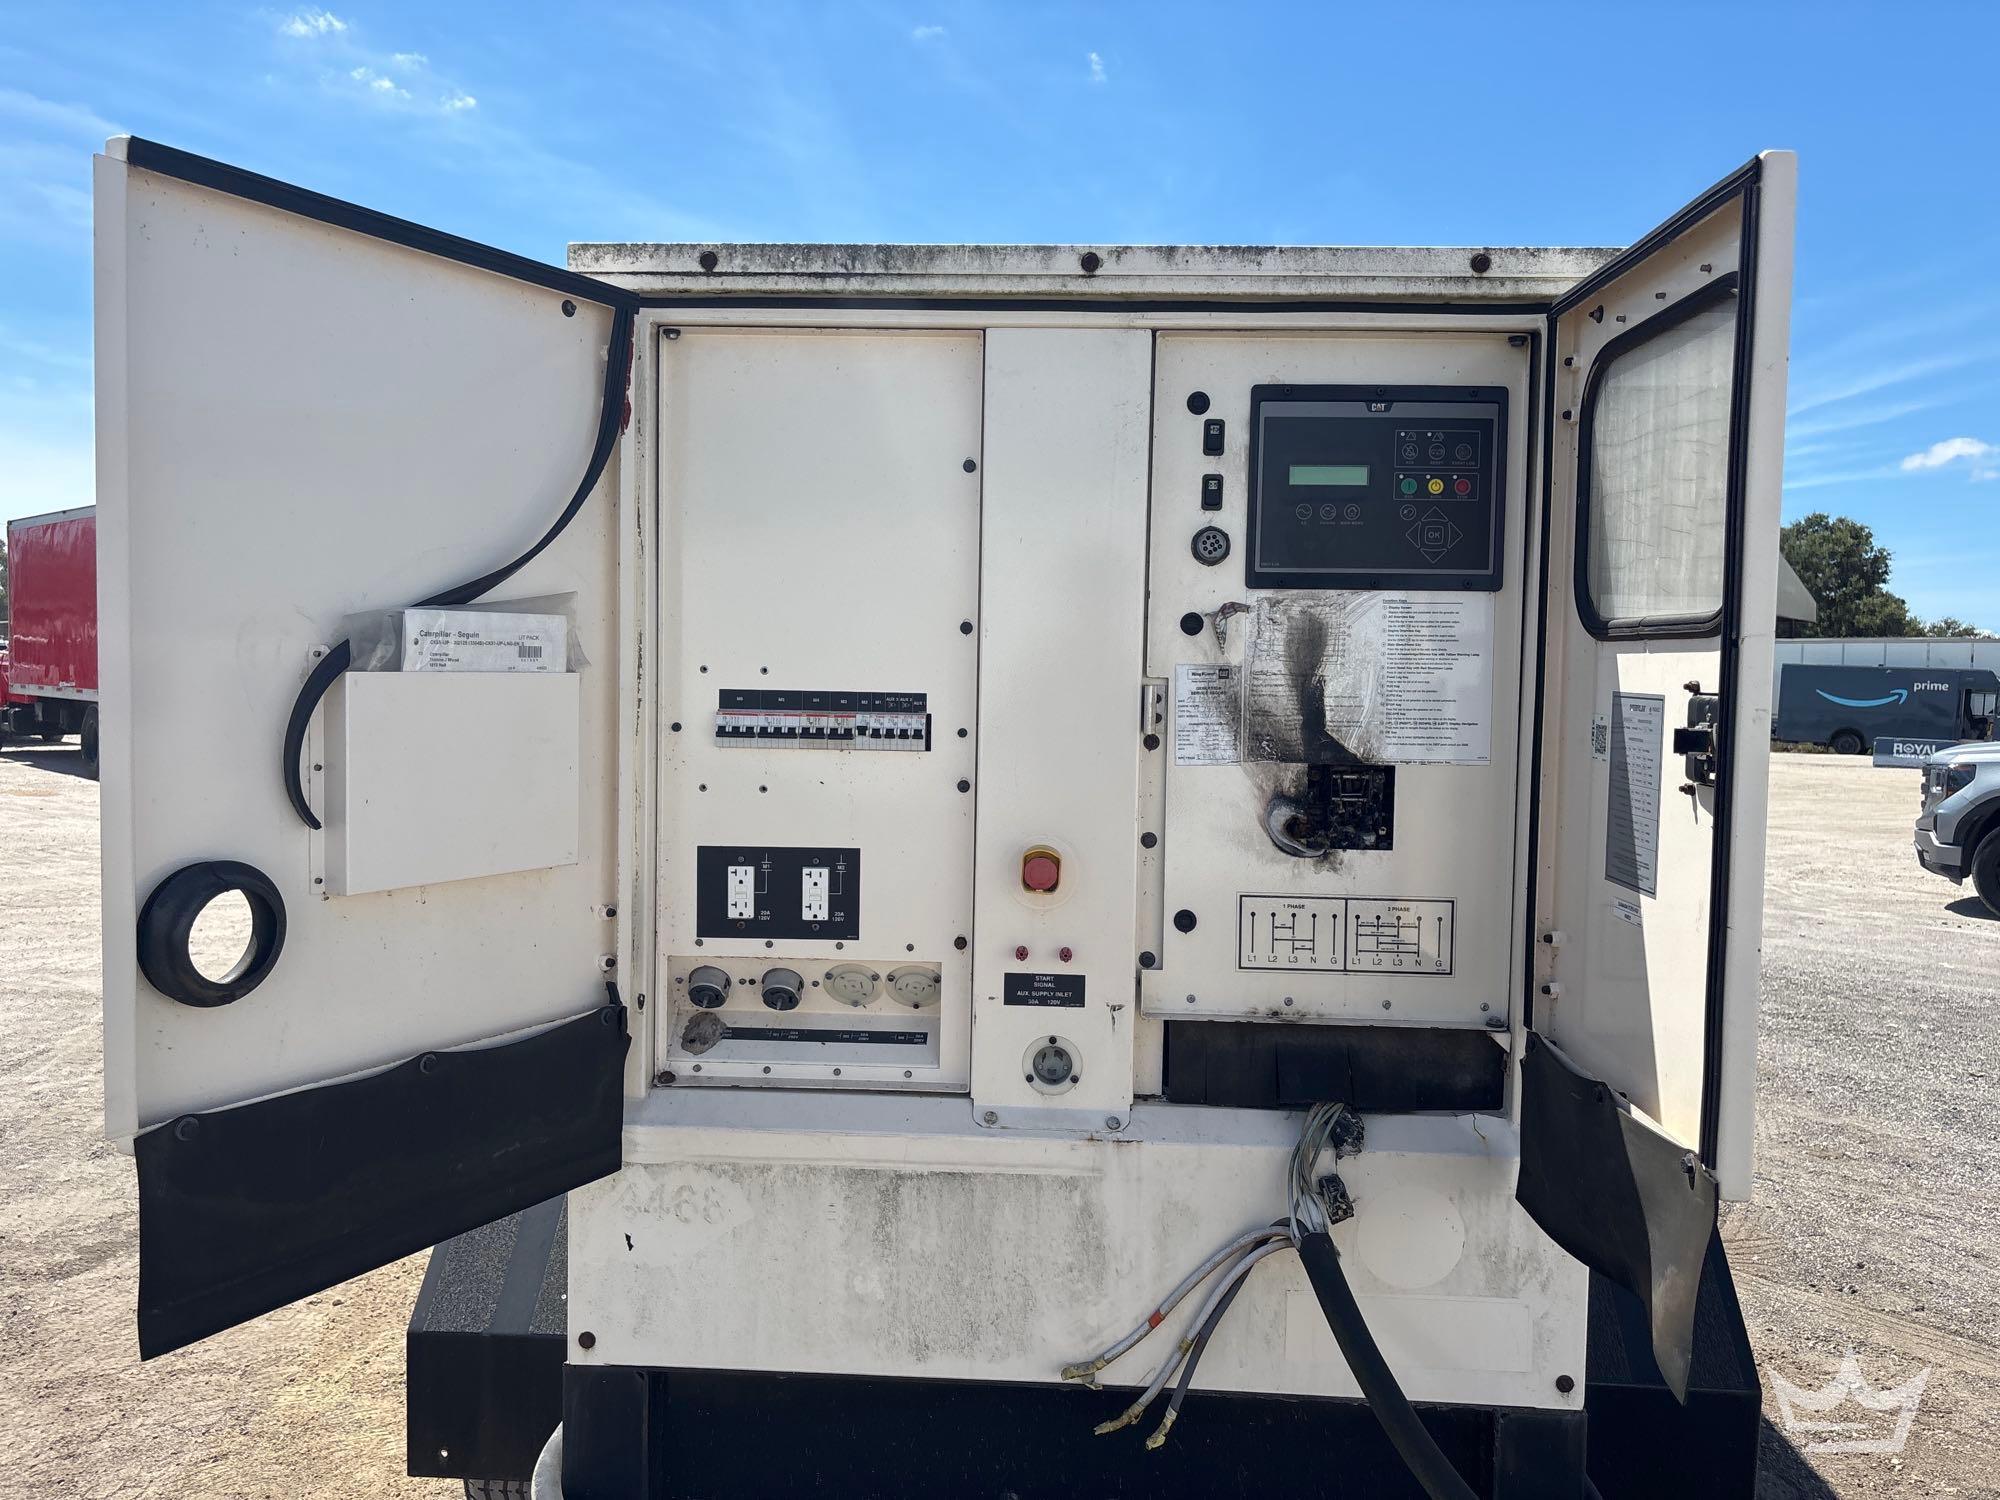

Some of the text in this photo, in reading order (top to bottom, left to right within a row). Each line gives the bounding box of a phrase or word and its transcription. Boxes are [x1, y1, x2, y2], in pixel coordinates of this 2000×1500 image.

[1371, 403, 1386, 412] CAT
[1428, 531, 1440, 539] OK
[419, 629, 452, 639] Caterpillar
[458, 631, 480, 640] Seguin
[1913, 680, 1949, 692] prime
[1247, 954, 1257, 962] L1
[1267, 955, 1278, 963] L2
[1288, 956, 1298, 964] L3
[1310, 956, 1317, 964] N
[1330, 956, 1338, 965] G
[1351, 957, 1361, 965] L1
[1372, 958, 1383, 966] L2
[1392, 958, 1403, 967] L3
[1415, 959, 1422, 967] N
[1435, 959, 1442, 968] G
